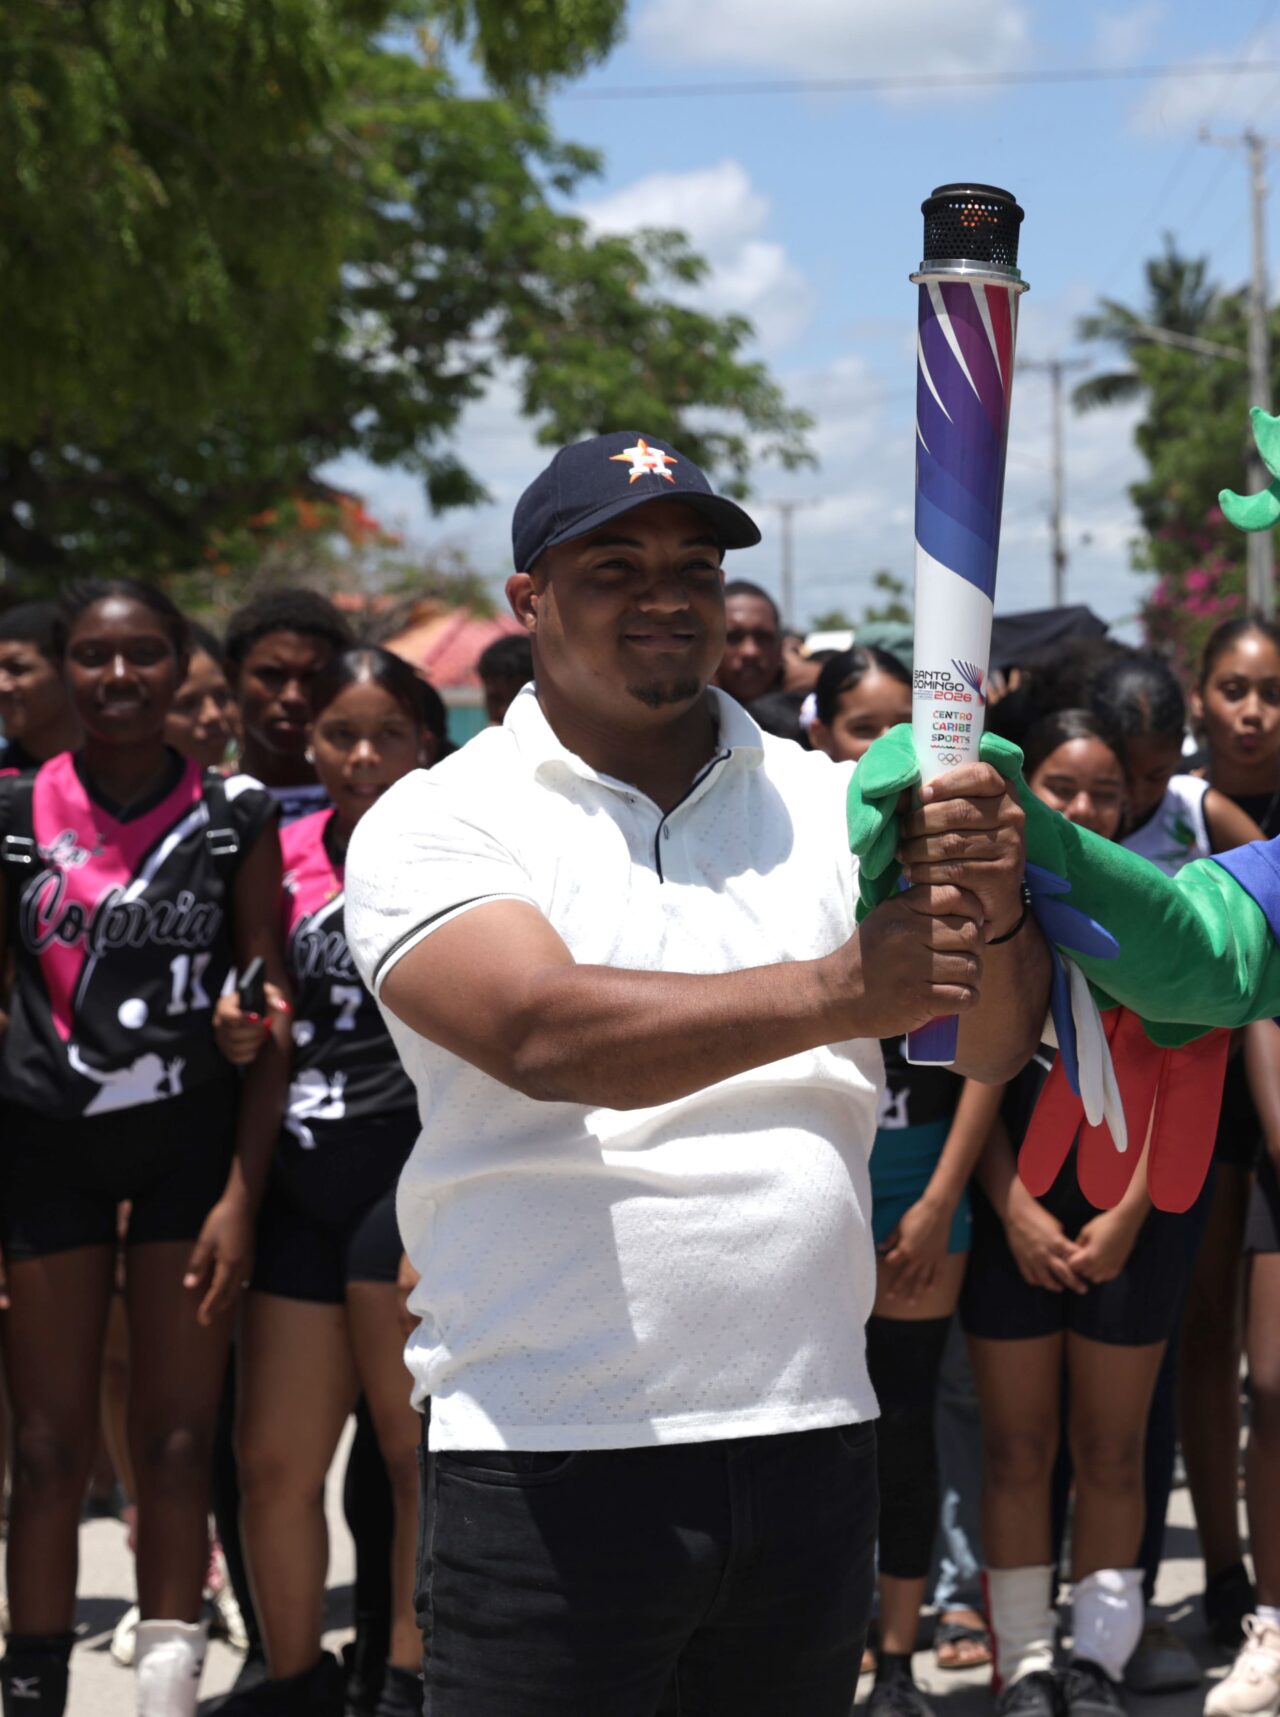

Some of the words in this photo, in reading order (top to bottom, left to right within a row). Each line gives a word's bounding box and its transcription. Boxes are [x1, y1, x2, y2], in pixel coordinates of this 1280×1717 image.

[623, 447, 672, 475] H
[914, 670, 951, 681] SANTO
[914, 679, 964, 692] DOMINGO
[934, 691, 972, 702] 2026
[933, 710, 972, 720] CENTRO
[932, 722, 971, 732] CARIBE
[931, 734, 970, 744] SPORTS
[20, 868, 223, 955] Colonia
[330, 984, 363, 1031] 7
